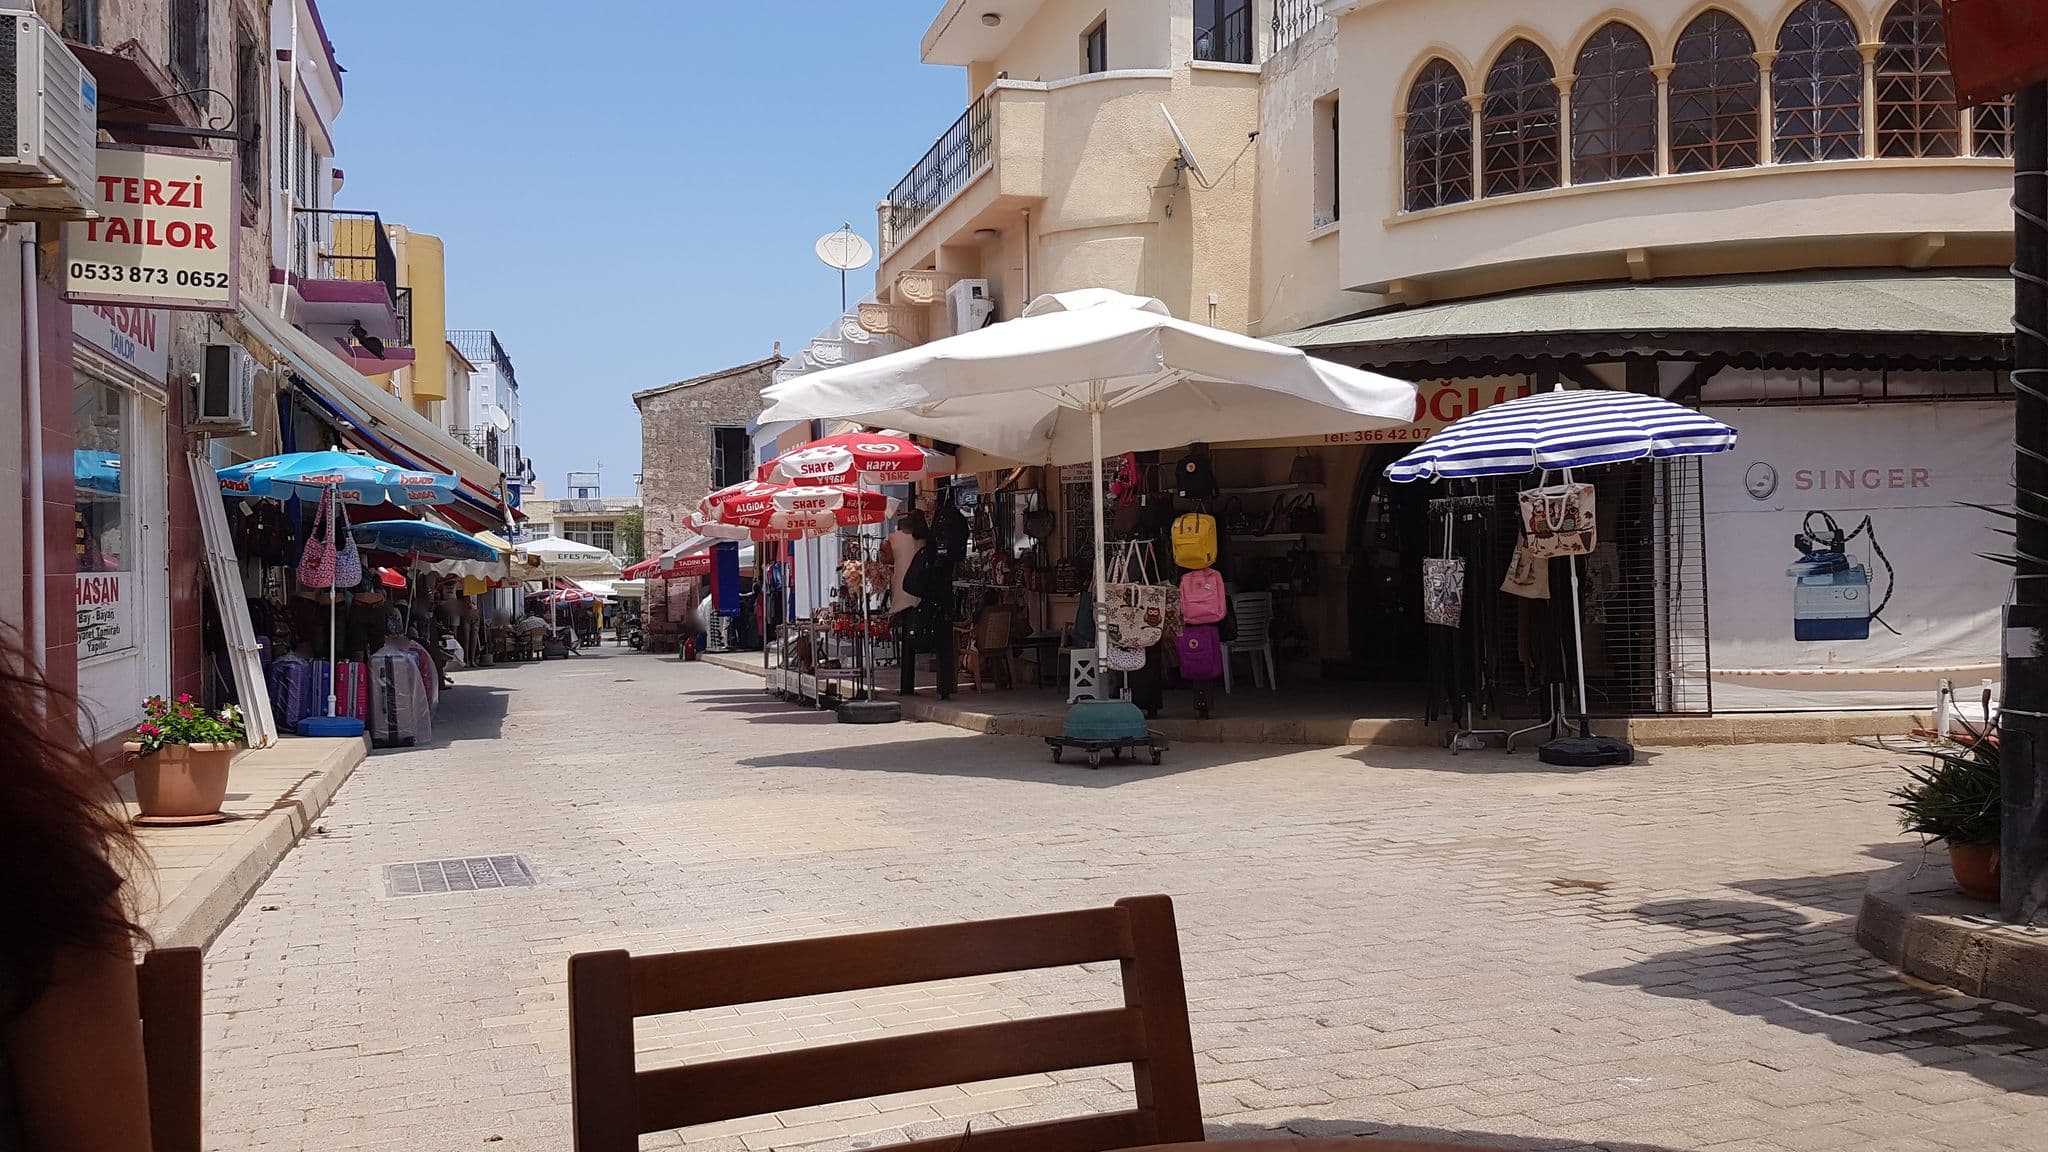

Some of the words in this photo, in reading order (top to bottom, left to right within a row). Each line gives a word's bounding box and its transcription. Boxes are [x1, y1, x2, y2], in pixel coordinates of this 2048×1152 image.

[97, 175, 203, 209] TERZİ
[87, 216, 218, 250] TAILOR
[70, 262, 124, 282] 0533
[129, 266, 168, 285] 873
[176, 269, 229, 289] 0652
[85, 306, 156, 352] ASAN
[110, 328, 135, 364] TAILOR
[1354, 431, 1383, 442] 366
[1387, 429, 1407, 440] 42
[1412, 428, 1431, 439] 07
[1794, 468, 1931, 490] SINGER
[75, 577, 118, 605] HASAN
